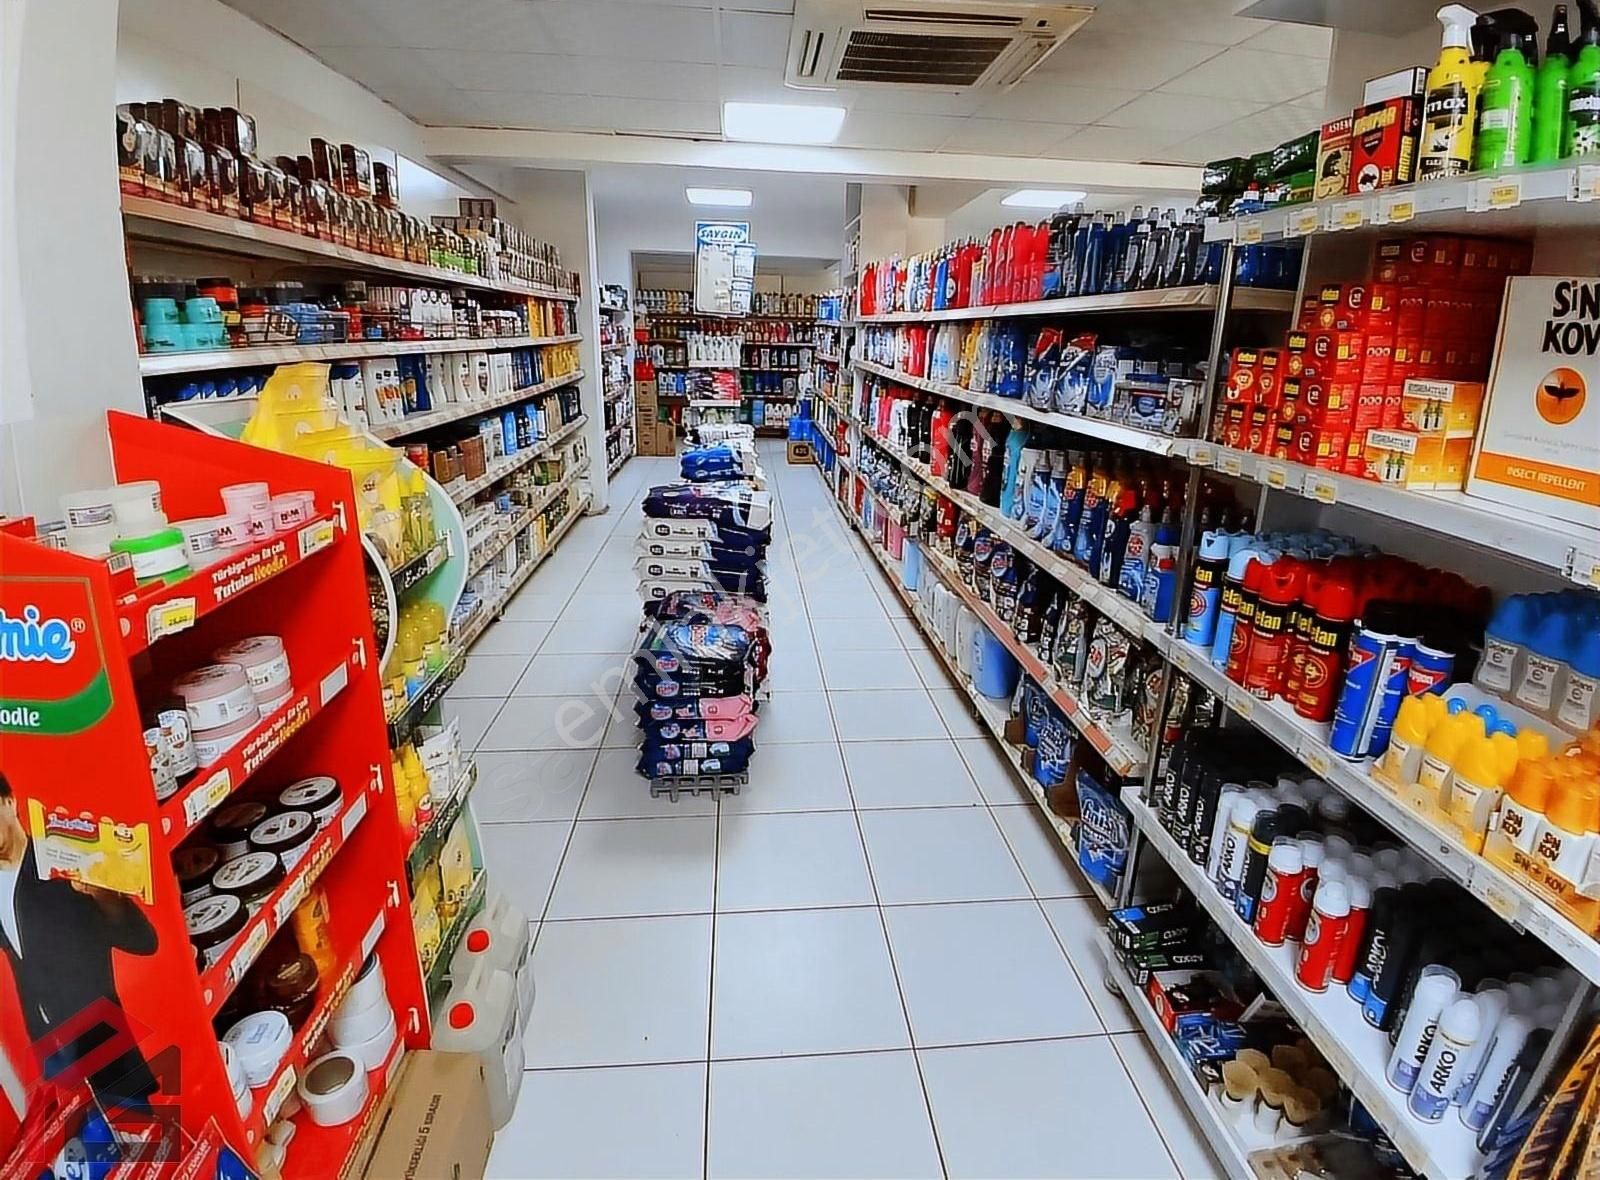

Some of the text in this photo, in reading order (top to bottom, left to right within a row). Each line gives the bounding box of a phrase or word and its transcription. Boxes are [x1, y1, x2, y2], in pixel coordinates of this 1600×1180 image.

[1542, 320, 1600, 356] KOV
[1506, 466, 1537, 481] INSECT
[1414, 1024, 1439, 1065] ARKO
[1429, 1050, 1457, 1094] ARKO
